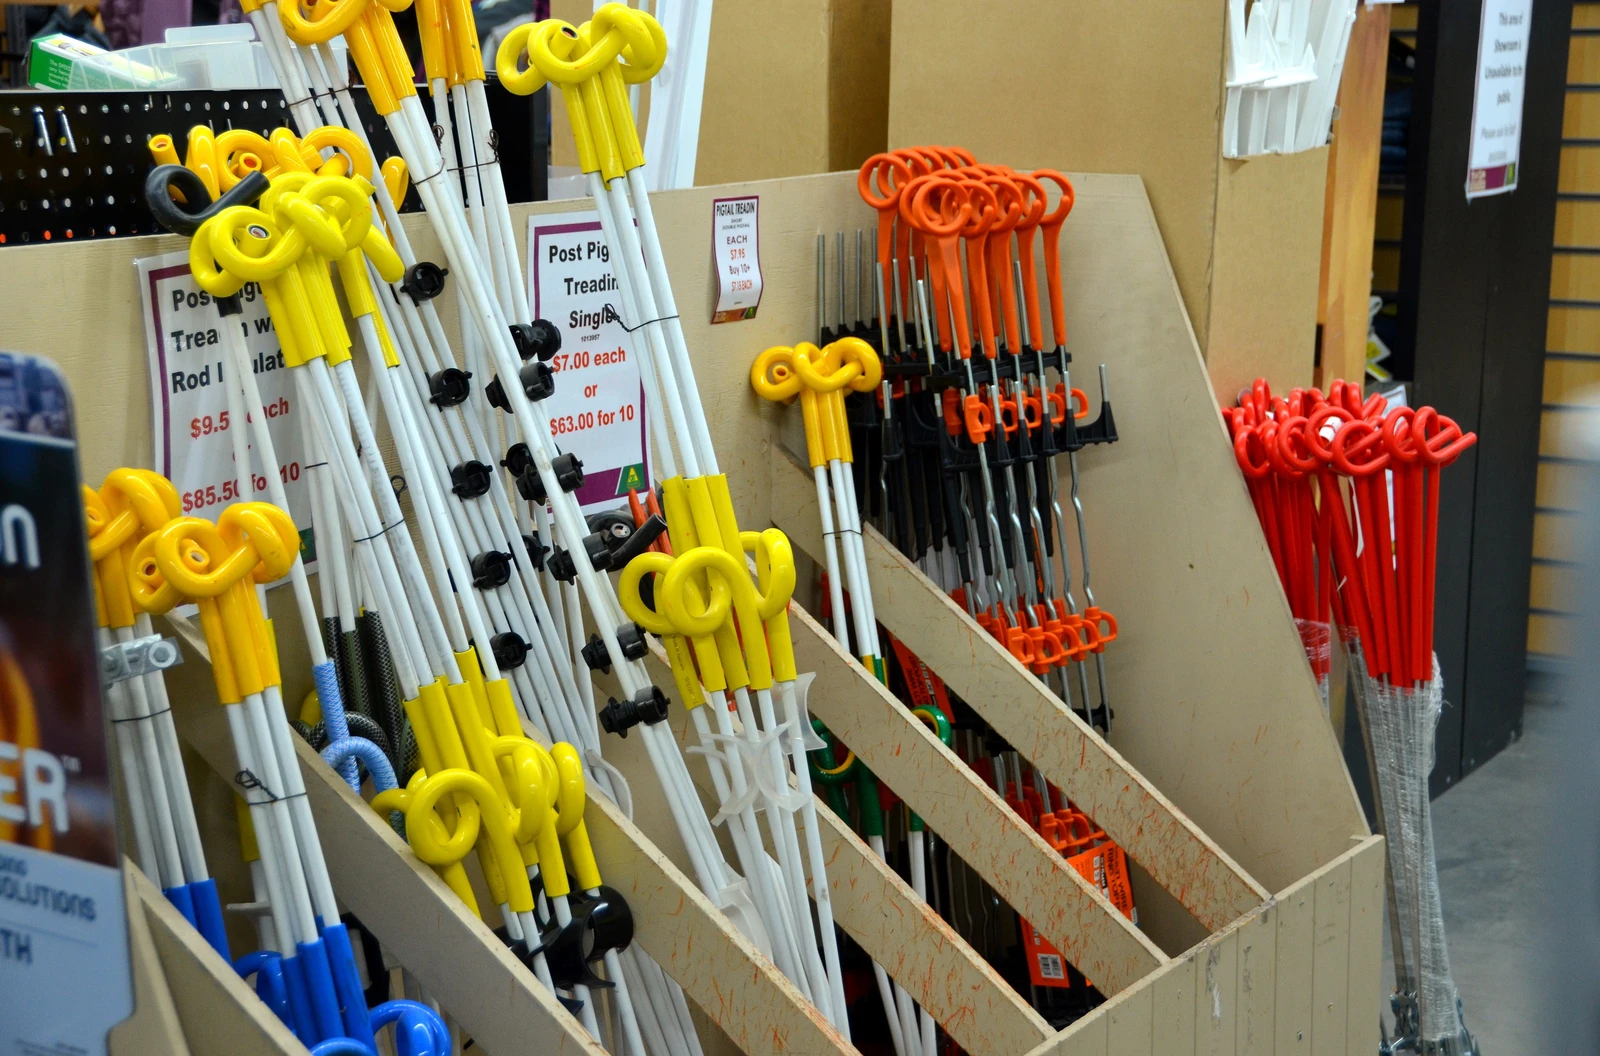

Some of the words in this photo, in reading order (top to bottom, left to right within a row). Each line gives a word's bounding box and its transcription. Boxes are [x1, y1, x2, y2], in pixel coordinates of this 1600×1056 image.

[716, 203, 735, 216] PIGTAIL
[735, 201, 756, 214] TREADIN
[726, 234, 748, 245] EACH
[549, 244, 582, 264] Post
[729, 265, 740, 276] Buy
[740, 263, 751, 274] 10+
[552, 351, 590, 374] $7.00
[594, 346, 626, 367] each
[172, 364, 211, 394] Rod
[584, 384, 598, 398] or
[190, 410, 230, 440] $9.5
[549, 411, 594, 437] $63.00
[597, 409, 616, 427] for
[619, 404, 634, 422] 10
[279, 461, 300, 485] 10
